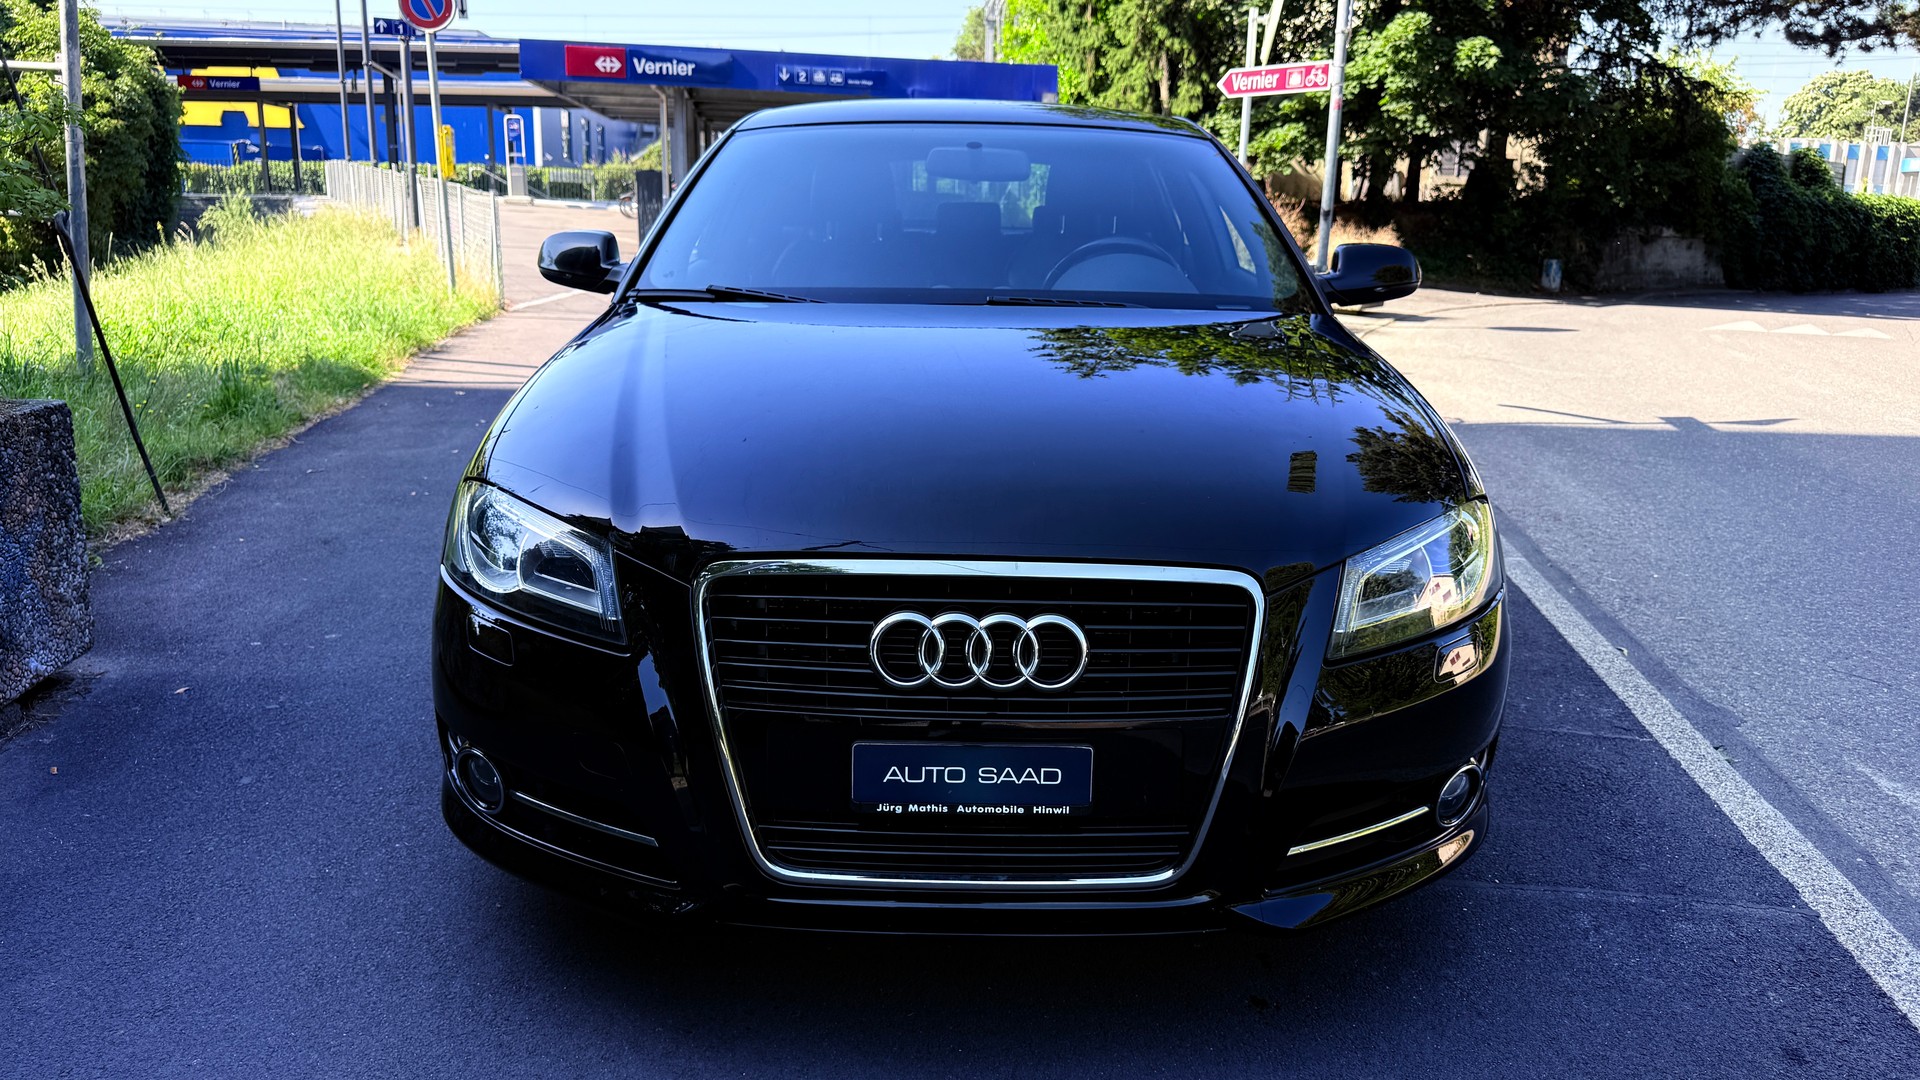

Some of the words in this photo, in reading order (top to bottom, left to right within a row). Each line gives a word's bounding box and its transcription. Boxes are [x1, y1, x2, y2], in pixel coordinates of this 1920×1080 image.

[633, 56, 696, 76] Vernier
[209, 79, 241, 89] Vernier
[797, 70, 807, 83] 2
[1231, 70, 1280, 92] Vernier
[883, 766, 966, 783] AUTO
[978, 767, 1062, 784] SAAD
[876, 803, 903, 814] Jürg
[908, 804, 948, 813] Mathis
[956, 804, 1025, 814] Automobile
[1033, 805, 1070, 814] Hinwil
